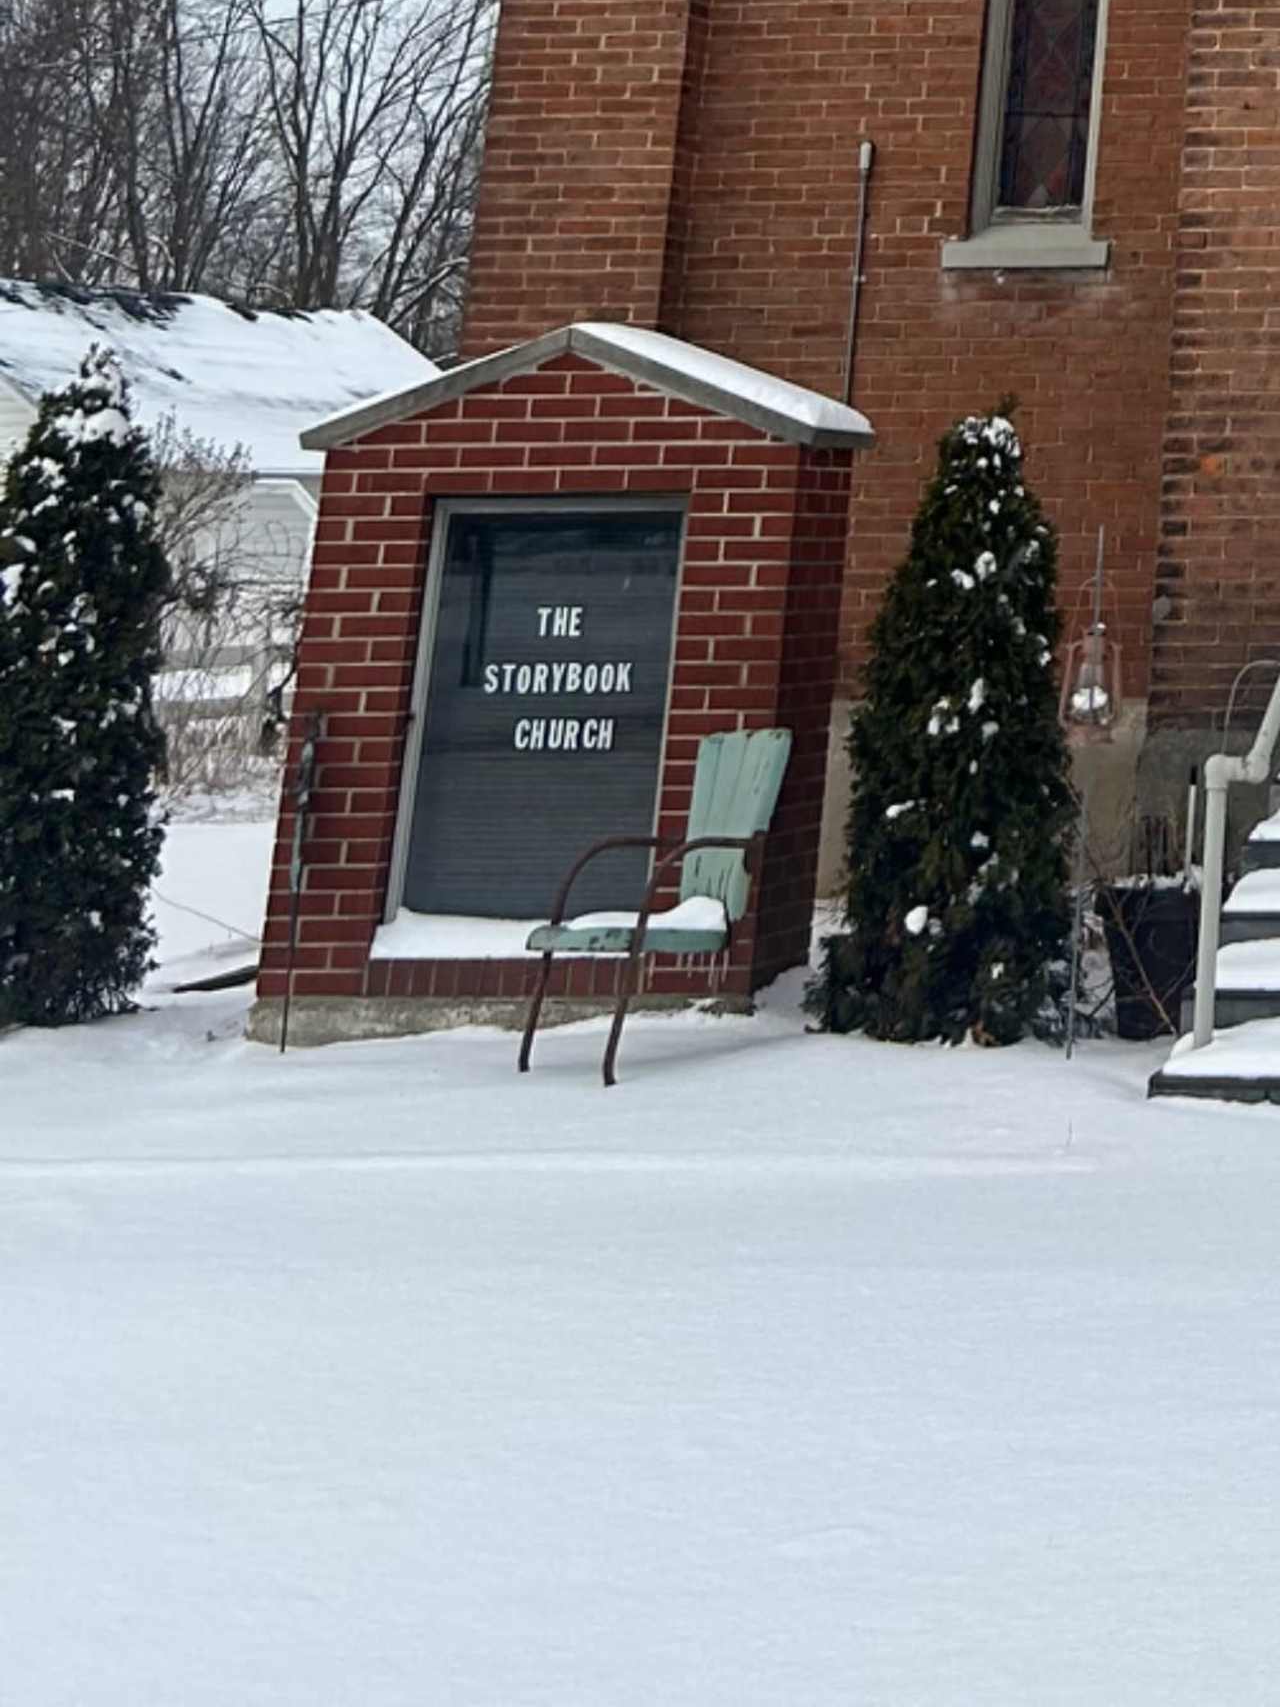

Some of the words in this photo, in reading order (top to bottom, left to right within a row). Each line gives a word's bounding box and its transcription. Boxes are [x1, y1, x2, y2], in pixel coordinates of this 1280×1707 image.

[537, 606, 583, 637] THE
[484, 662, 632, 694] STORYBOOK
[514, 718, 614, 750] CHURCH
